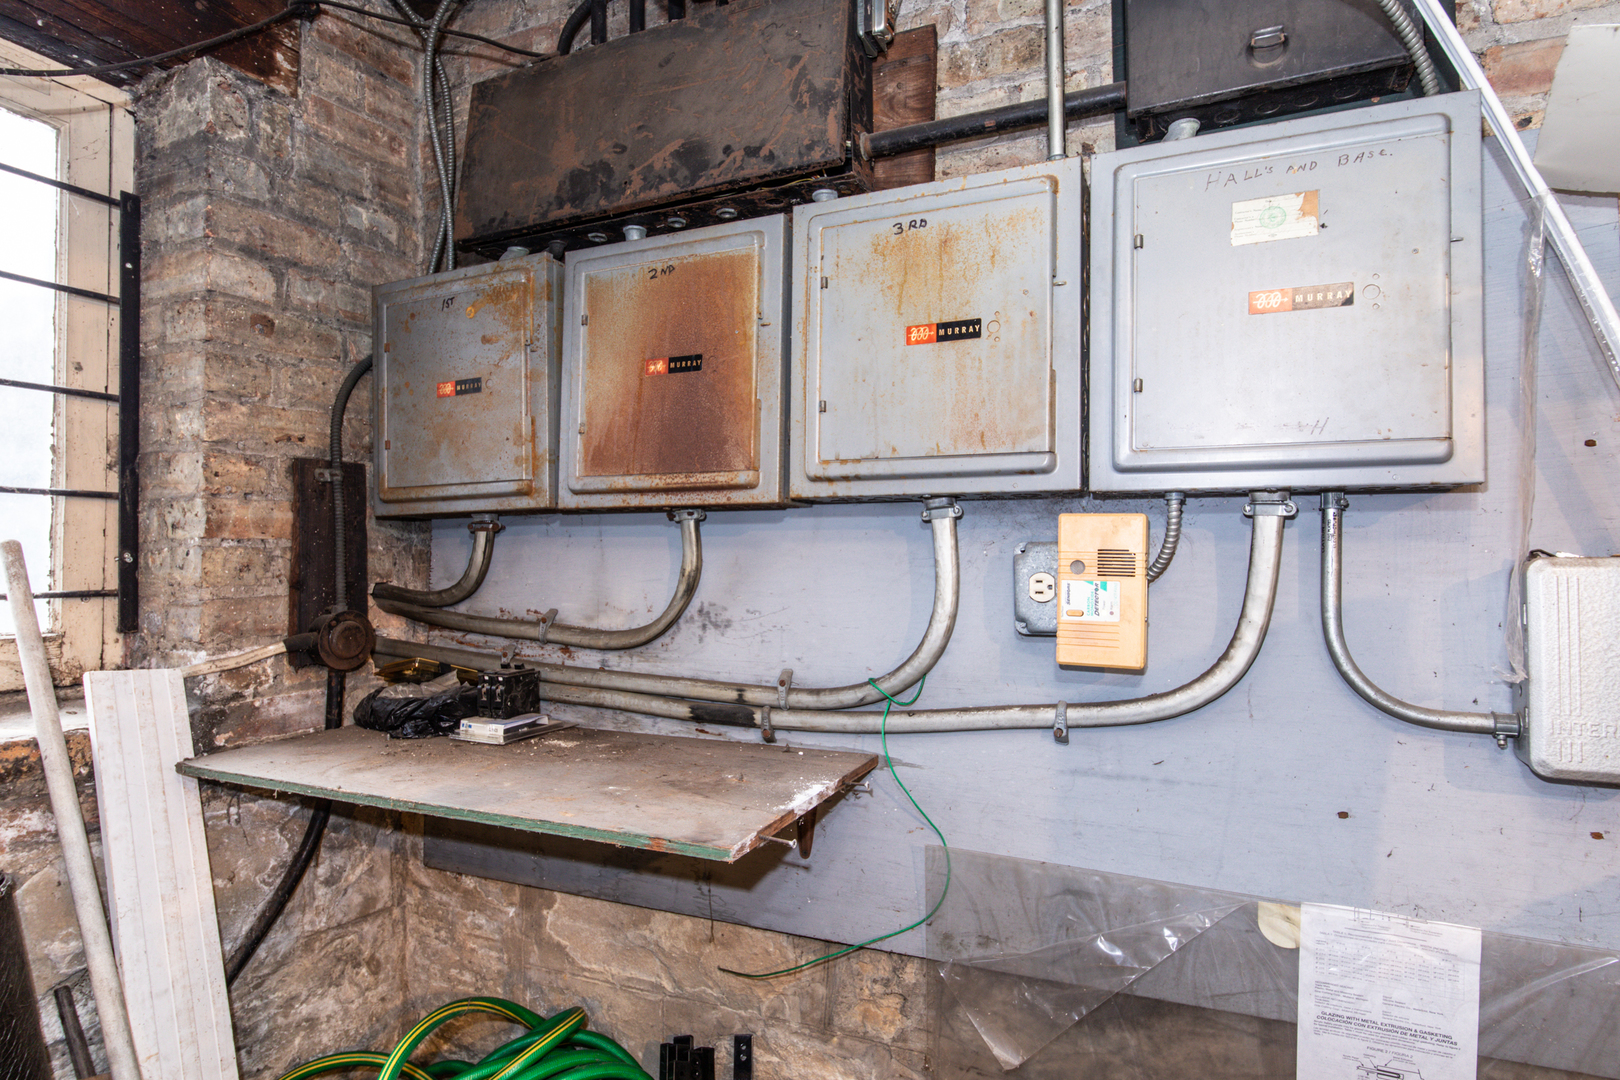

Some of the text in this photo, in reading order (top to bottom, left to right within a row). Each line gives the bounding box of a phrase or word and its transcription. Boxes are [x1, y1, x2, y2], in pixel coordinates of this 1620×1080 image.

[1285, 160, 1318, 174] AND
[1295, 290, 1352, 303] MURRAY
[938, 324, 980, 337] MURRAY
[669, 359, 702, 370] MURRAY
[456, 381, 482, 392] MURRAY
[1320, 1010, 1345, 1019] GLAZING
[1360, 1018, 1379, 1026] METAL
[1380, 1022, 1413, 1032] EXTRUSION
[1418, 1030, 1453, 1040] GASKETING
[1409, 1032, 1428, 1041] METAL
